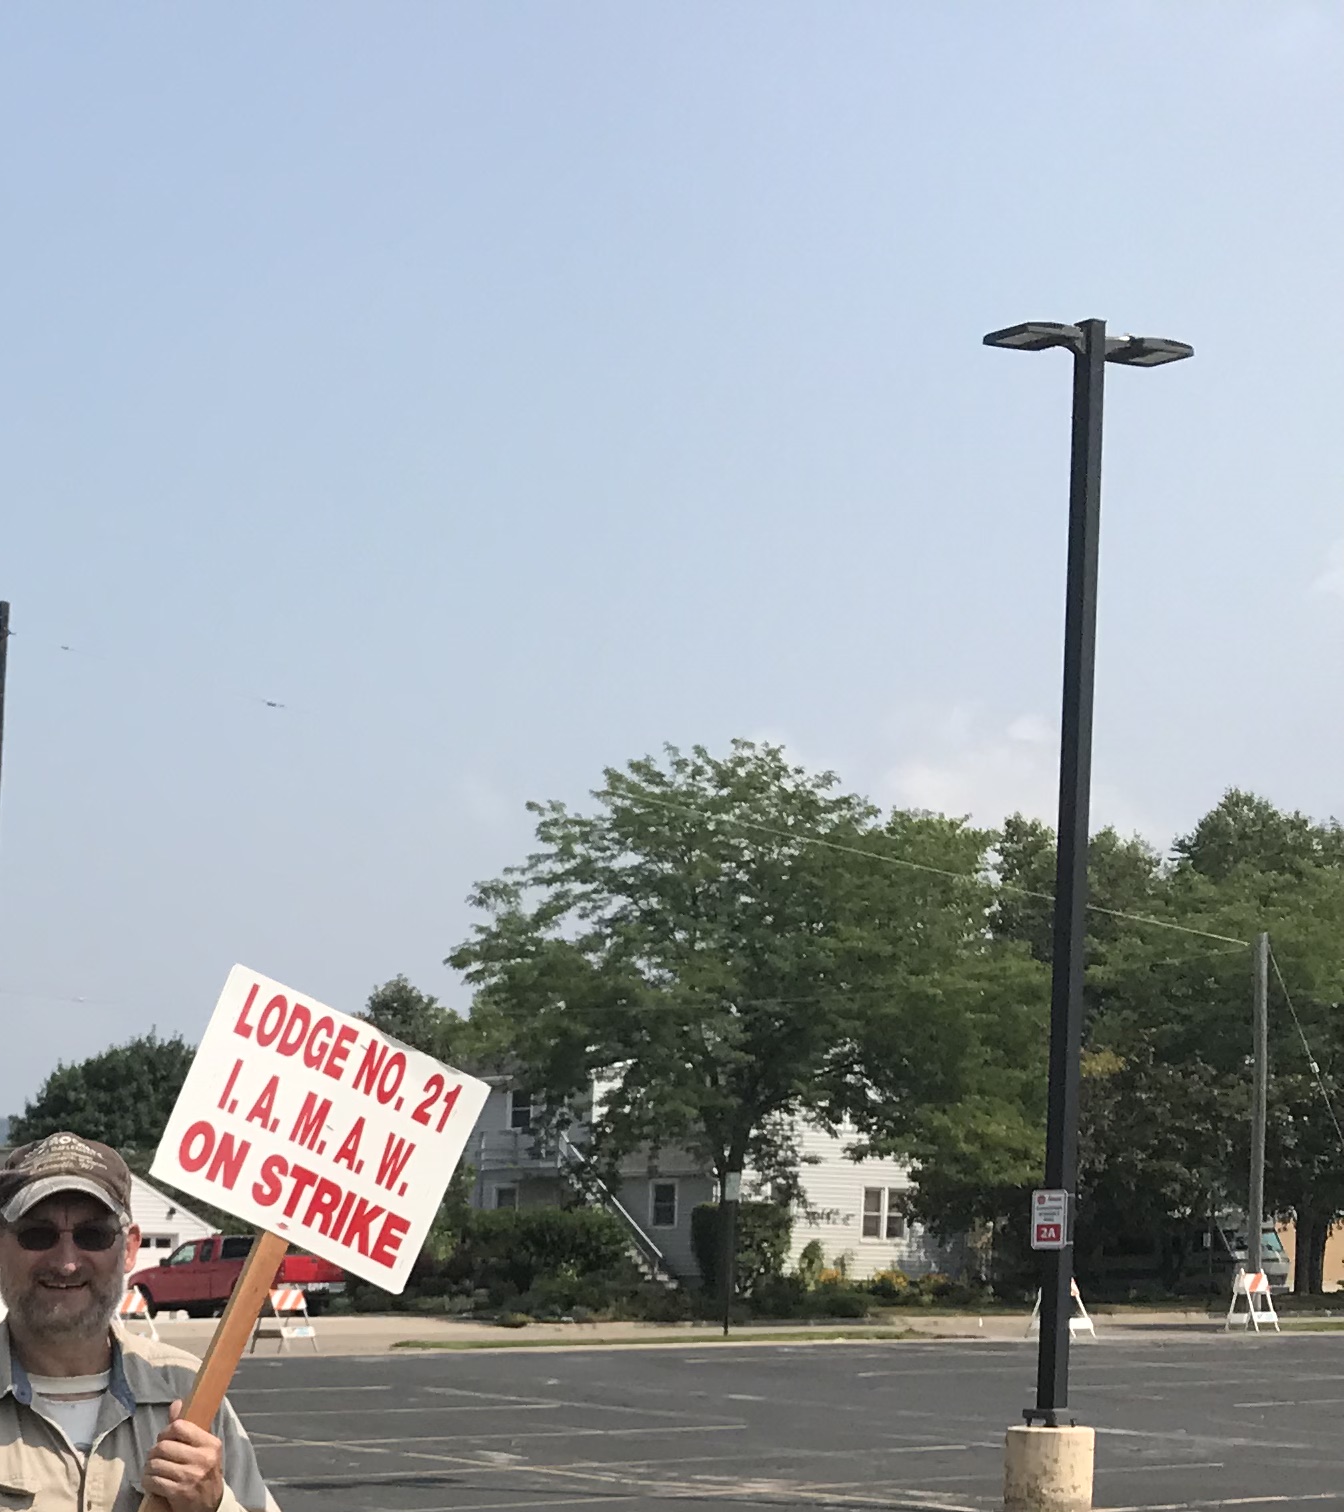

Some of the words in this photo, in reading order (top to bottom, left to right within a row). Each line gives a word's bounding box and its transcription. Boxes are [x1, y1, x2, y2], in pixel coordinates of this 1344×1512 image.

[234, 983, 359, 1081] LODGE
[352, 1038, 406, 1112] NO.
[411, 1073, 462, 1133] 21
[178, 1120, 251, 1190] ON
[252, 1154, 411, 1269] STRIKE
[1040, 1227, 1056, 1239] 2A
